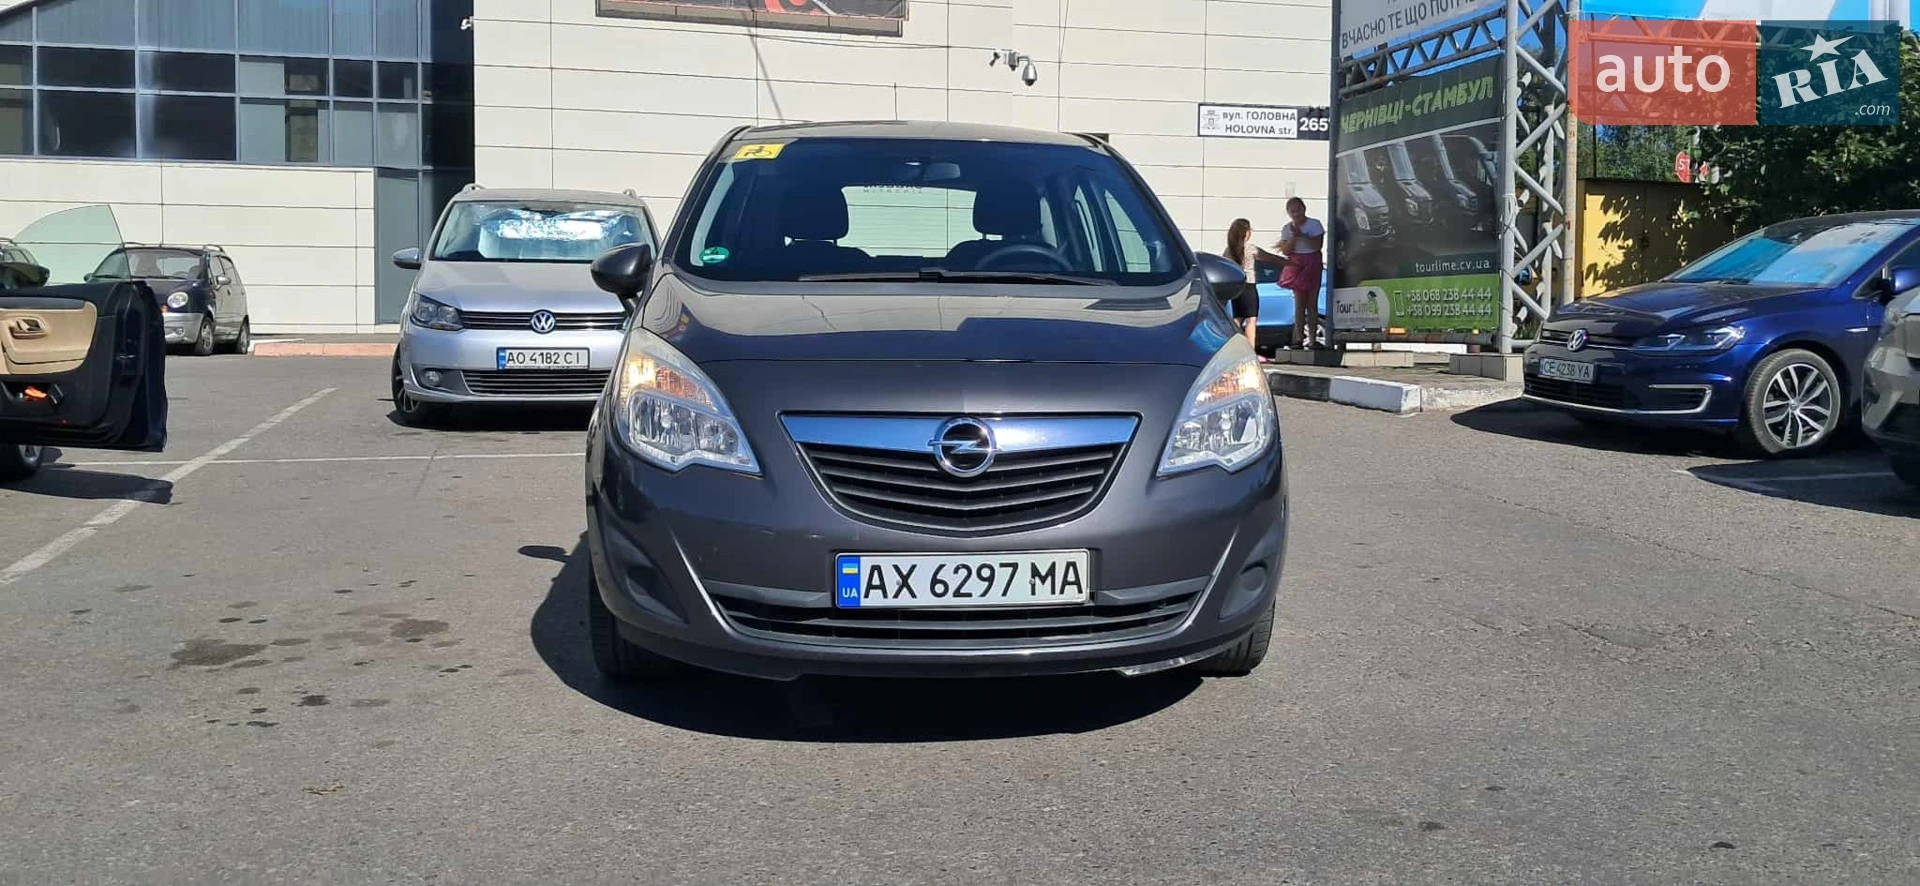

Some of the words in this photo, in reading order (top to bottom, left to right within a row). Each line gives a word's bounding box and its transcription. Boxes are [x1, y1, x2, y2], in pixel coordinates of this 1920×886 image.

[1341, 18, 1386, 49] ВЧАСНО
[1388, 11, 1402, 31] ТЕ
[1405, 3, 1427, 26] ЩО
[1341, 76, 1494, 133] ЧЕРНІВЦІ-СТАМБУЛ
[1222, 111, 1243, 121] вул.
[1246, 111, 1296, 121] ГОЛОВНА
[1225, 124, 1276, 135] HOLOVNA
[1278, 127, 1295, 135] str.
[1299, 117, 1330, 131] 265
[1415, 259, 1490, 273] tourlime.cv.ua
[529, 352, 560, 364] 4182
[863, 564, 918, 599] AX
[929, 562, 1019, 598] 6297
[1030, 561, 1084, 596] MA
[842, 587, 858, 598] UA
